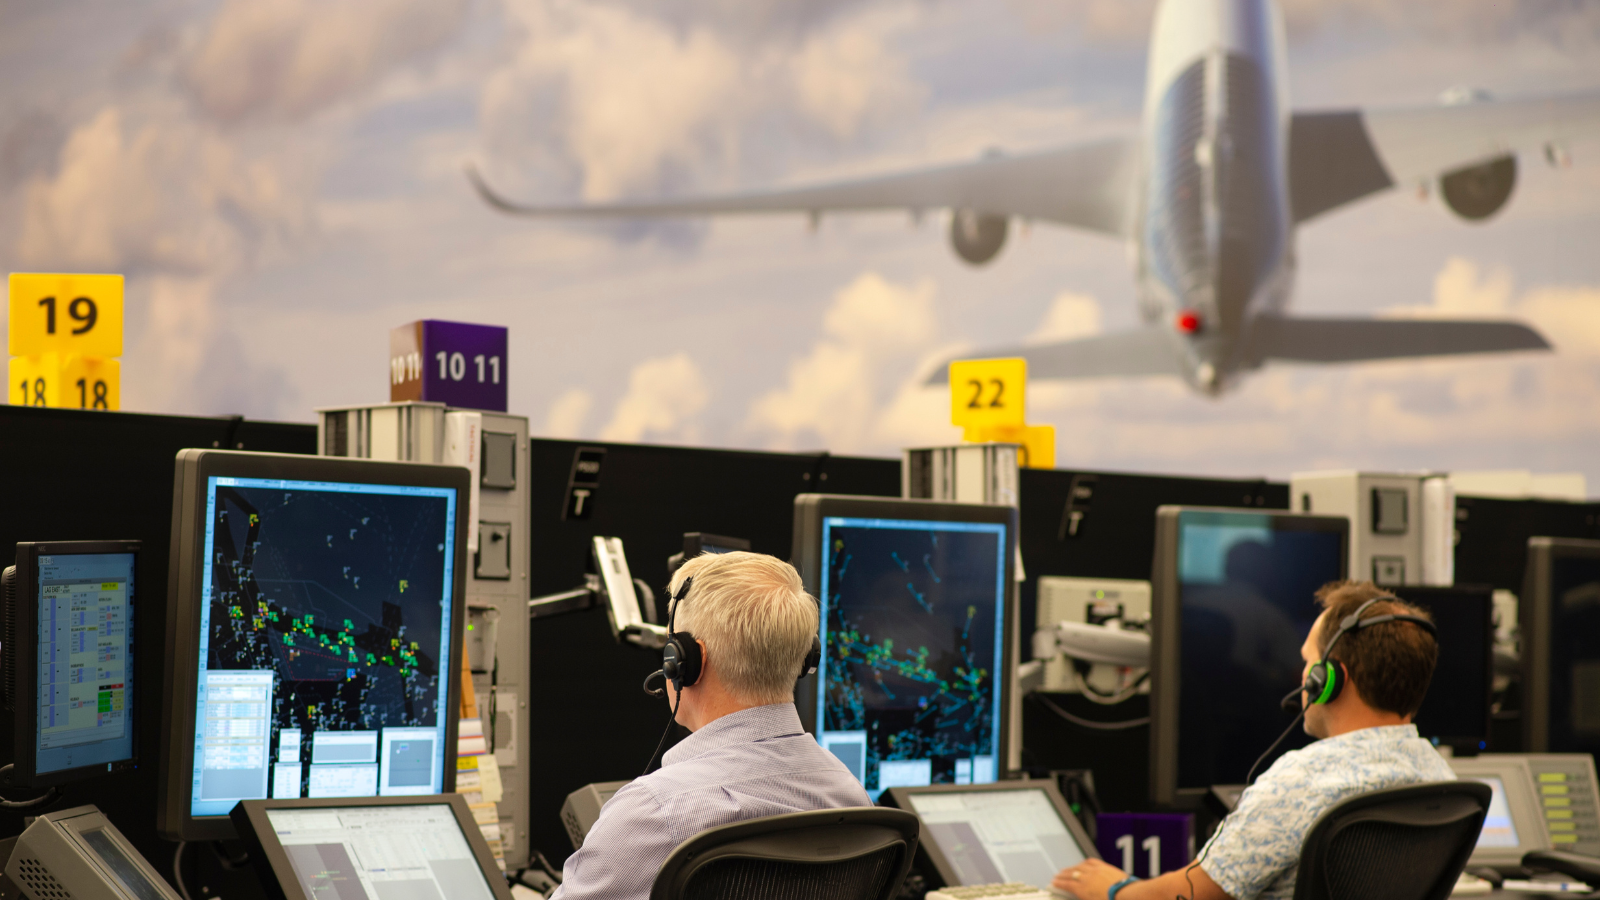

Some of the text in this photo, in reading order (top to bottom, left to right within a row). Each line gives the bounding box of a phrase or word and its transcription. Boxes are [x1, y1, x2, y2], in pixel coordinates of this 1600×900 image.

[38, 296, 98, 335] 19
[391, 350, 420, 386] 10 11
[436, 350, 501, 384] 10 11
[20, 376, 46, 406] 18
[76, 377, 108, 410] 18
[967, 379, 1006, 409] 22
[574, 489, 591, 516] T
[1069, 510, 1084, 536] T
[1115, 834, 1161, 879] 11
